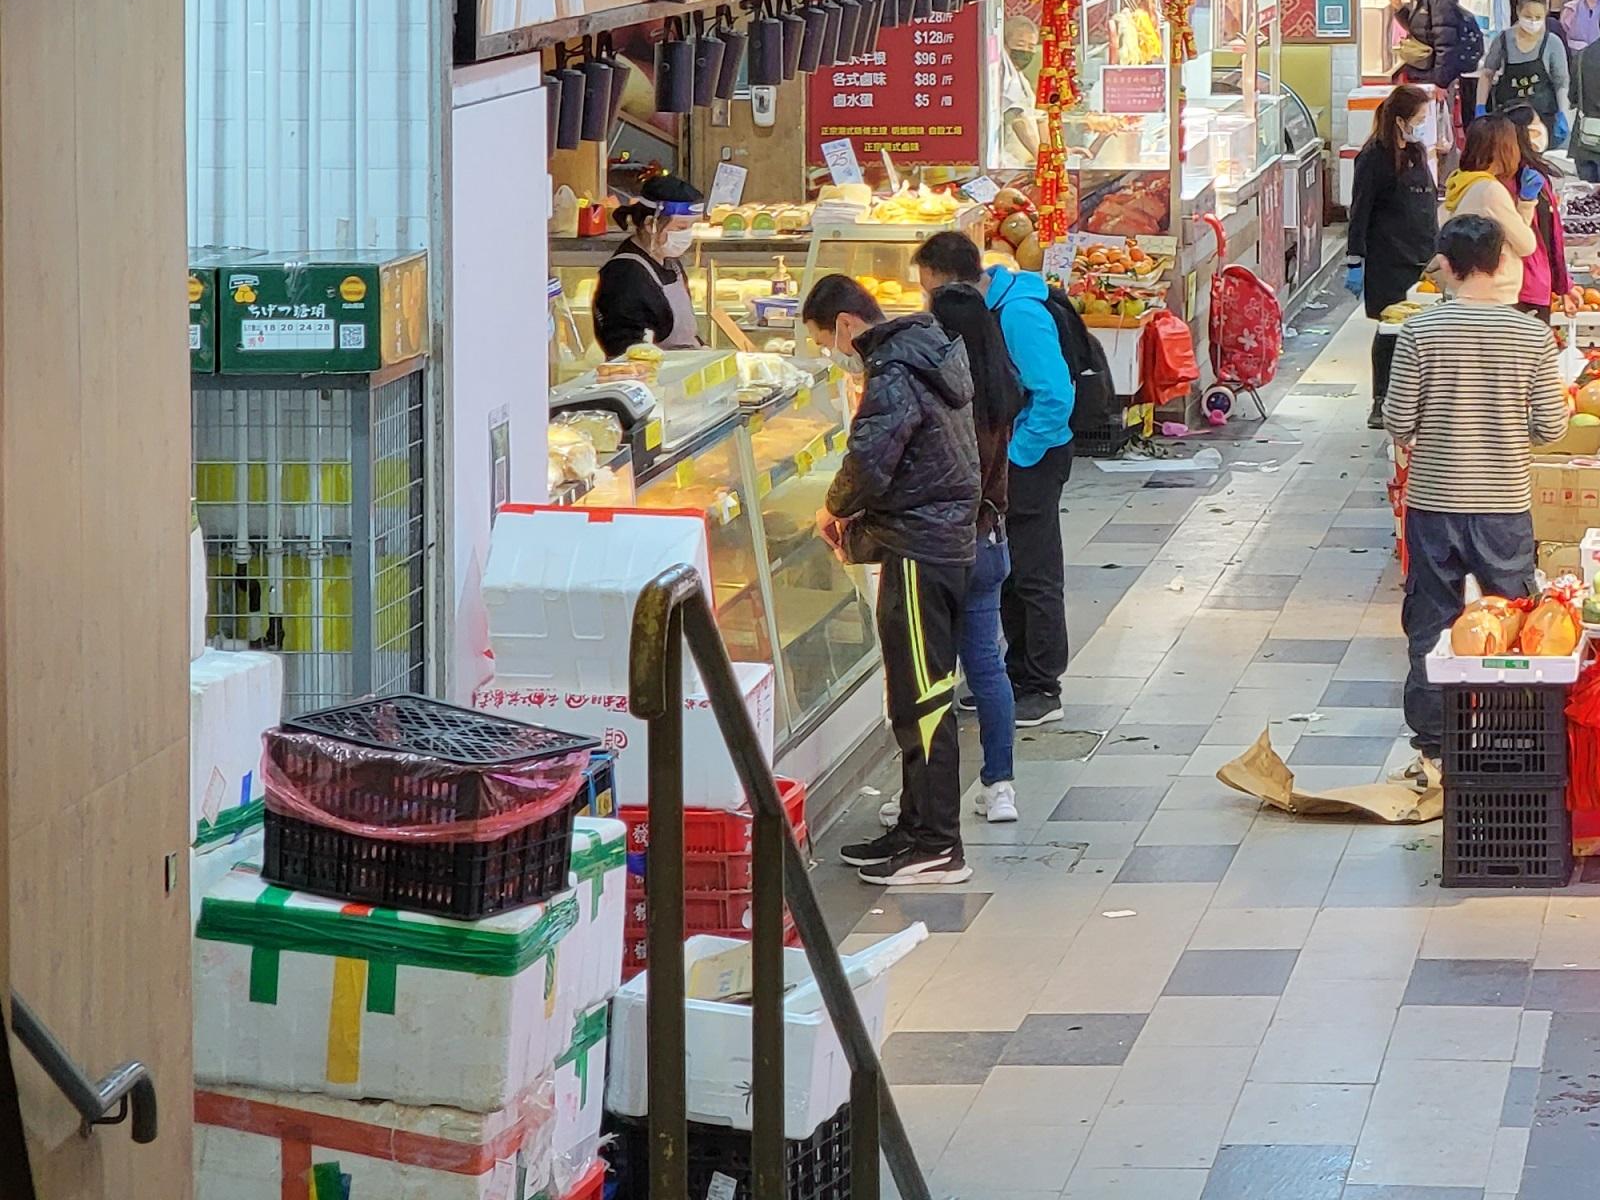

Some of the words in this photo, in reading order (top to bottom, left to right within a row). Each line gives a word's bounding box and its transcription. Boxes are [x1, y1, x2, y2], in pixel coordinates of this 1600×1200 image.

[914, 52, 937, 66] $96
[914, 73, 937, 87] $88
[914, 93, 930, 108] $5
[828, 152, 849, 167] 25
[280, 324, 294, 332] 20
[299, 324, 313, 332] 24
